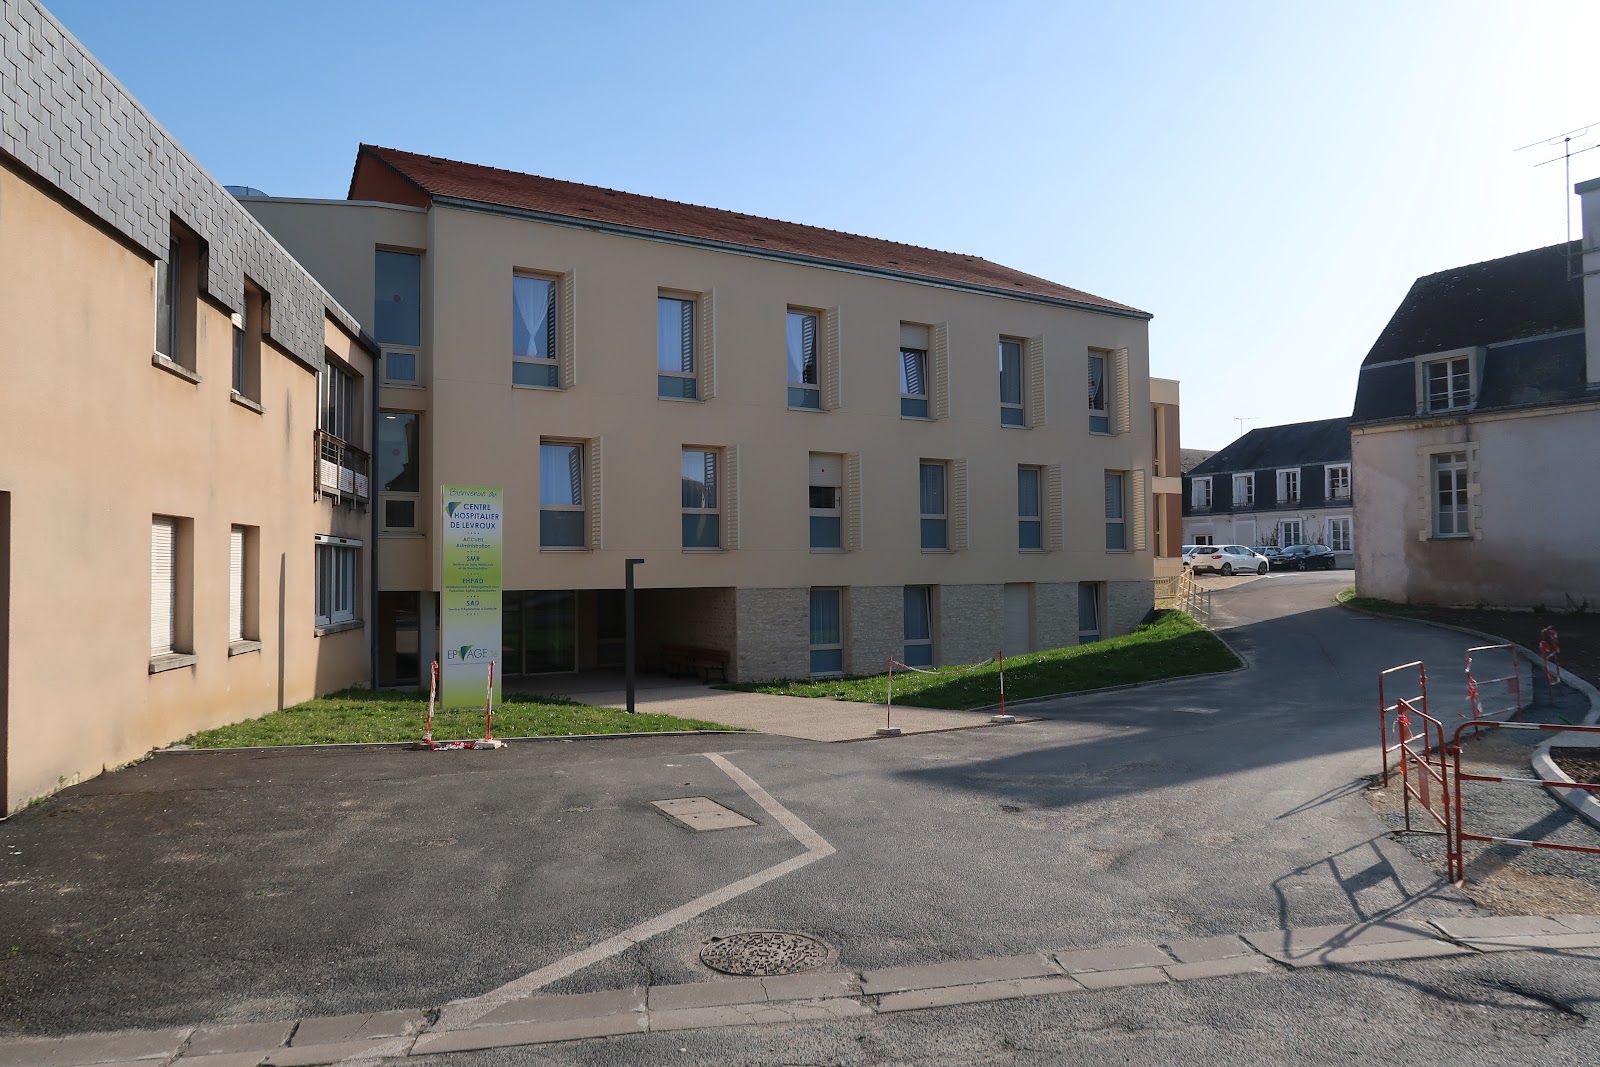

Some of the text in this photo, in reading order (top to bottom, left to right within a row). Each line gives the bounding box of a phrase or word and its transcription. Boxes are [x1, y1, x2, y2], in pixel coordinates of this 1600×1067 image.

[449, 487, 487, 497] Bienvenue
[463, 503, 491, 511] CENTRE
[454, 512, 500, 520] HOSPITALIER
[450, 521, 496, 530] DE LEVROUX
